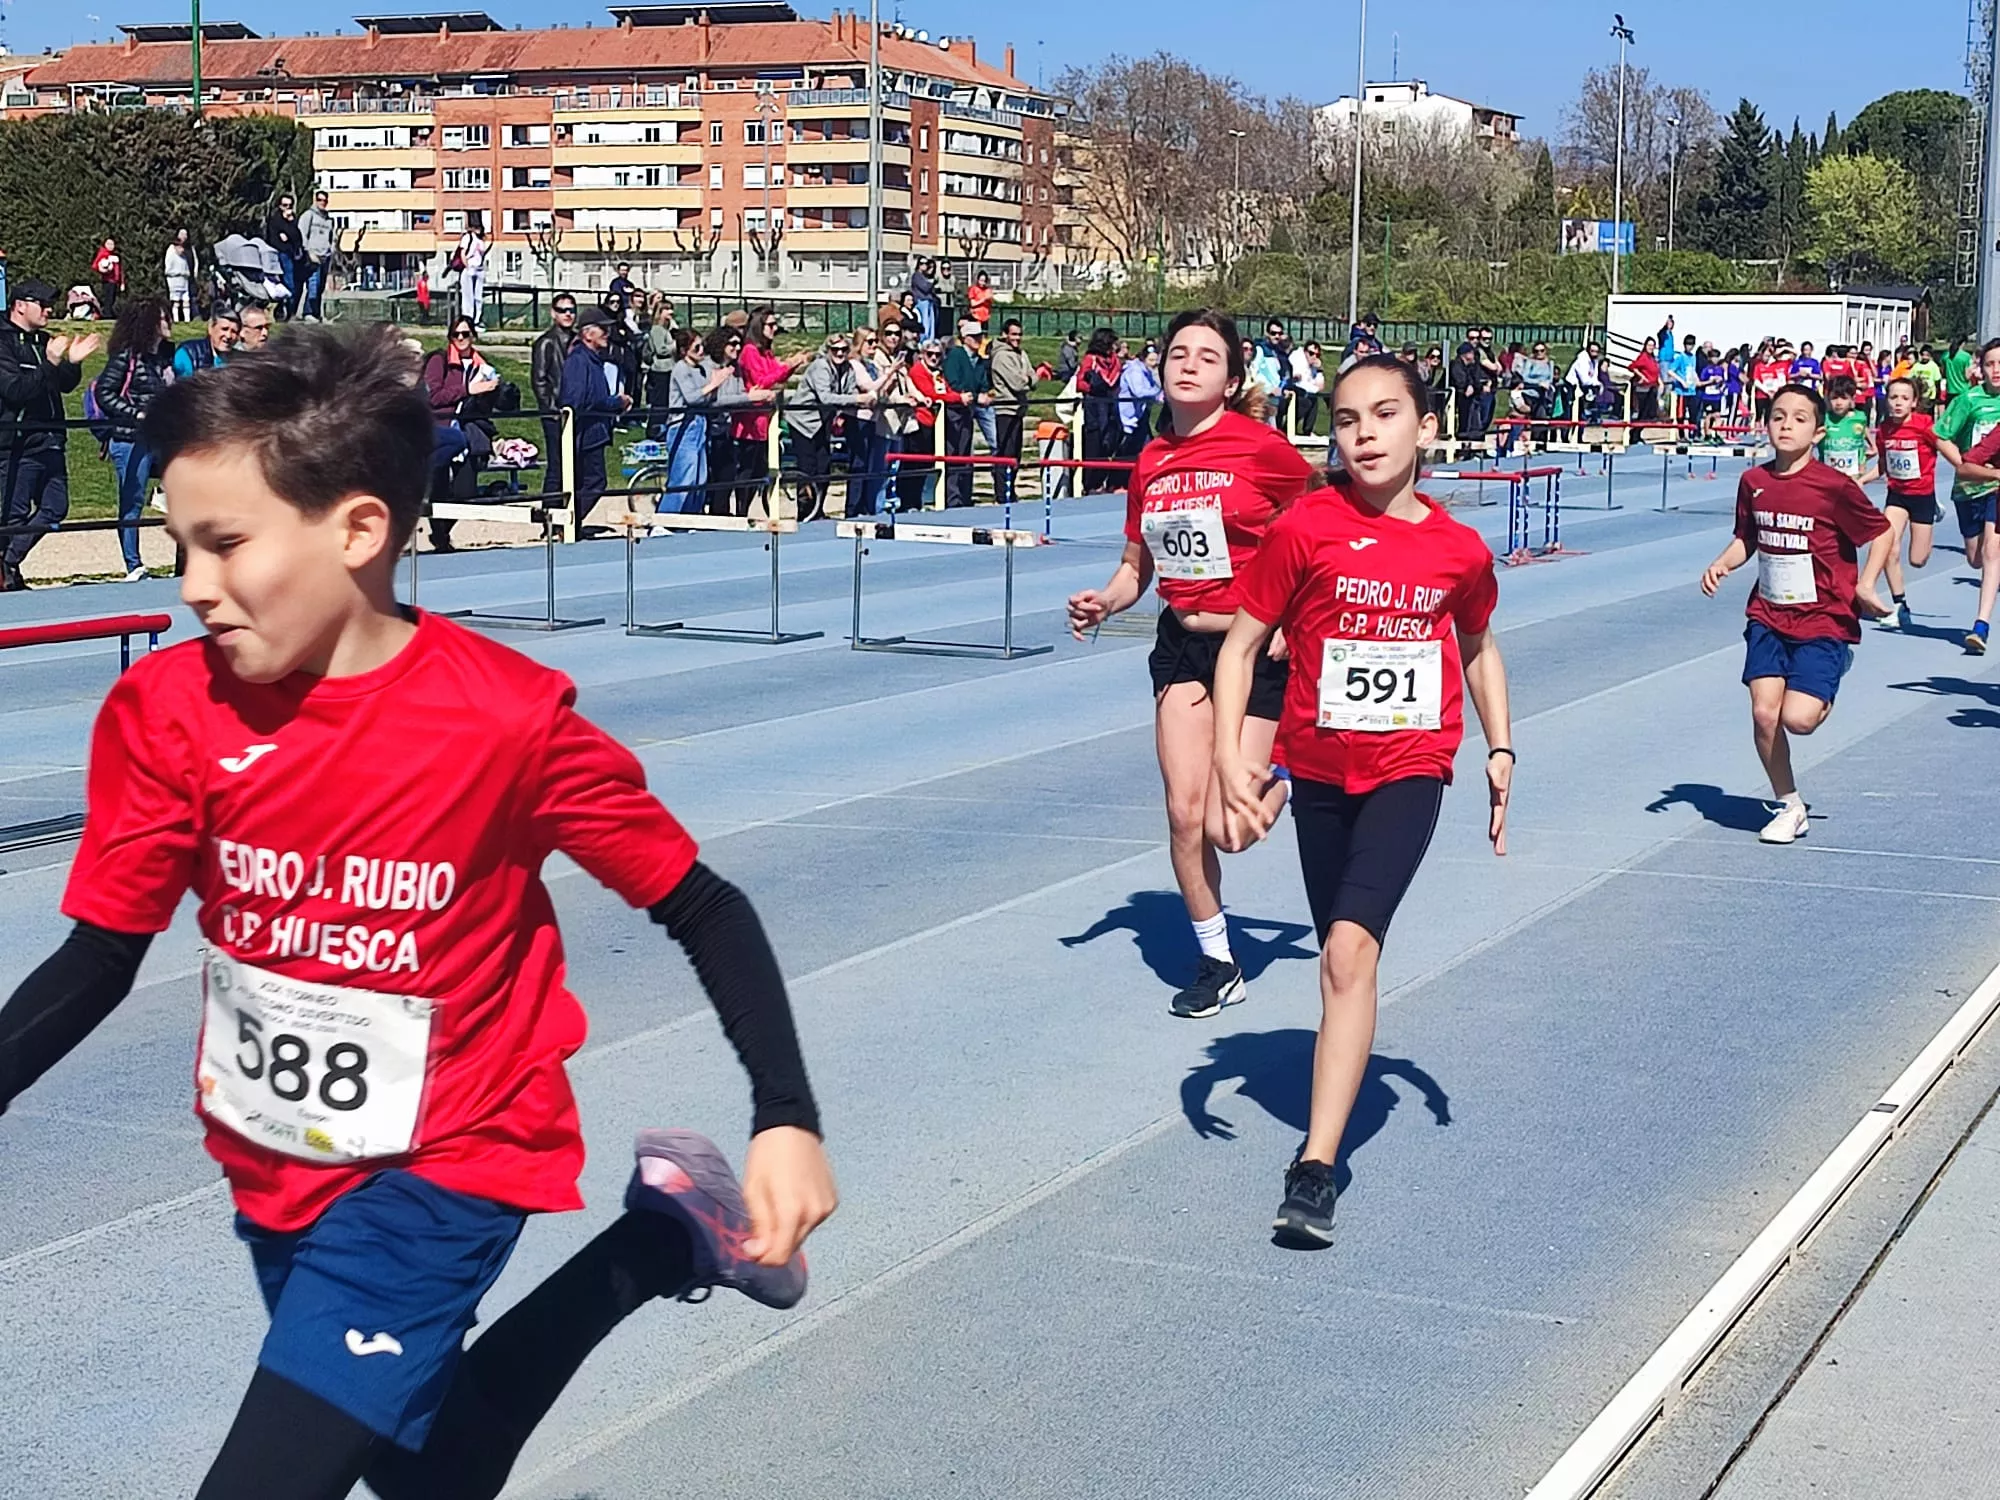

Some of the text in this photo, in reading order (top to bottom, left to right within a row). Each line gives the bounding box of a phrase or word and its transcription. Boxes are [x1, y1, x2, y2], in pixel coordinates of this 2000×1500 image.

[1163, 530, 1210, 557] 603
[1335, 575, 1393, 608] PEDRO
[1394, 584, 1408, 610] J.
[1339, 612, 1433, 641] C.P. HUESCA
[1345, 667, 1417, 704] 591
[218, 838, 457, 912] EDRO J. RUBIO
[267, 914, 421, 974] HUESCA
[235, 1007, 368, 1112] 588
